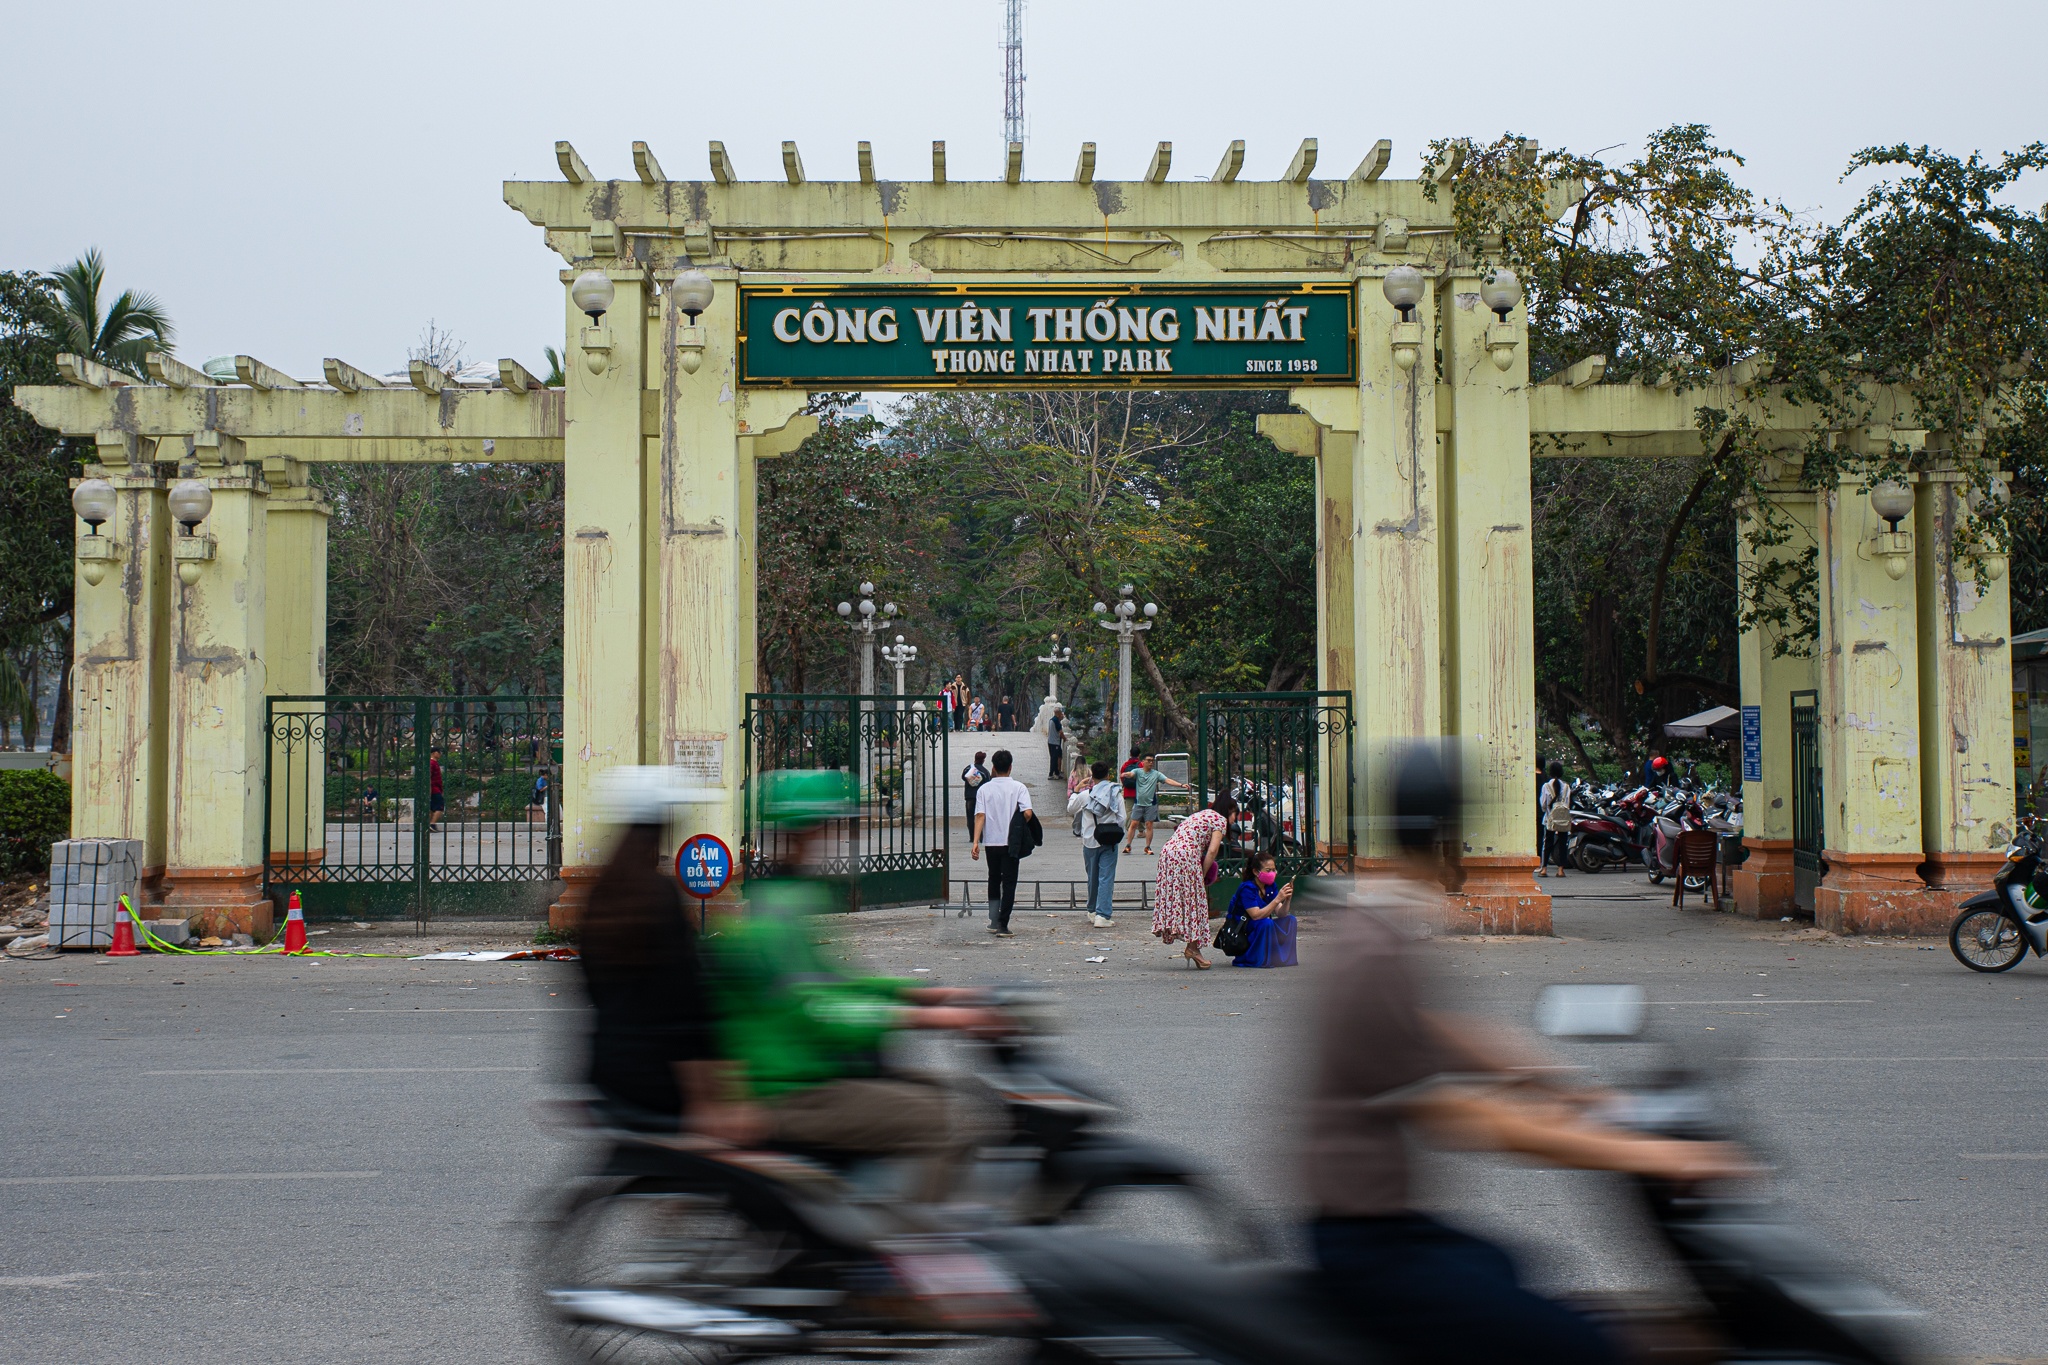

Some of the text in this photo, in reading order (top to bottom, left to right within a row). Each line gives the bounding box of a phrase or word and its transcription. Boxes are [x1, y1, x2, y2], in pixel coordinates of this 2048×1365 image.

[772, 297, 1309, 343] CÔNG VIÊN THỐNG NHẤT
[932, 349, 1173, 373] THONG NHAT PARK
[1246, 360, 1318, 372] SINCE 1958
[691, 843, 719, 861] CẤM
[706, 866, 723, 877] XE
[697, 880, 720, 888] PARKING
